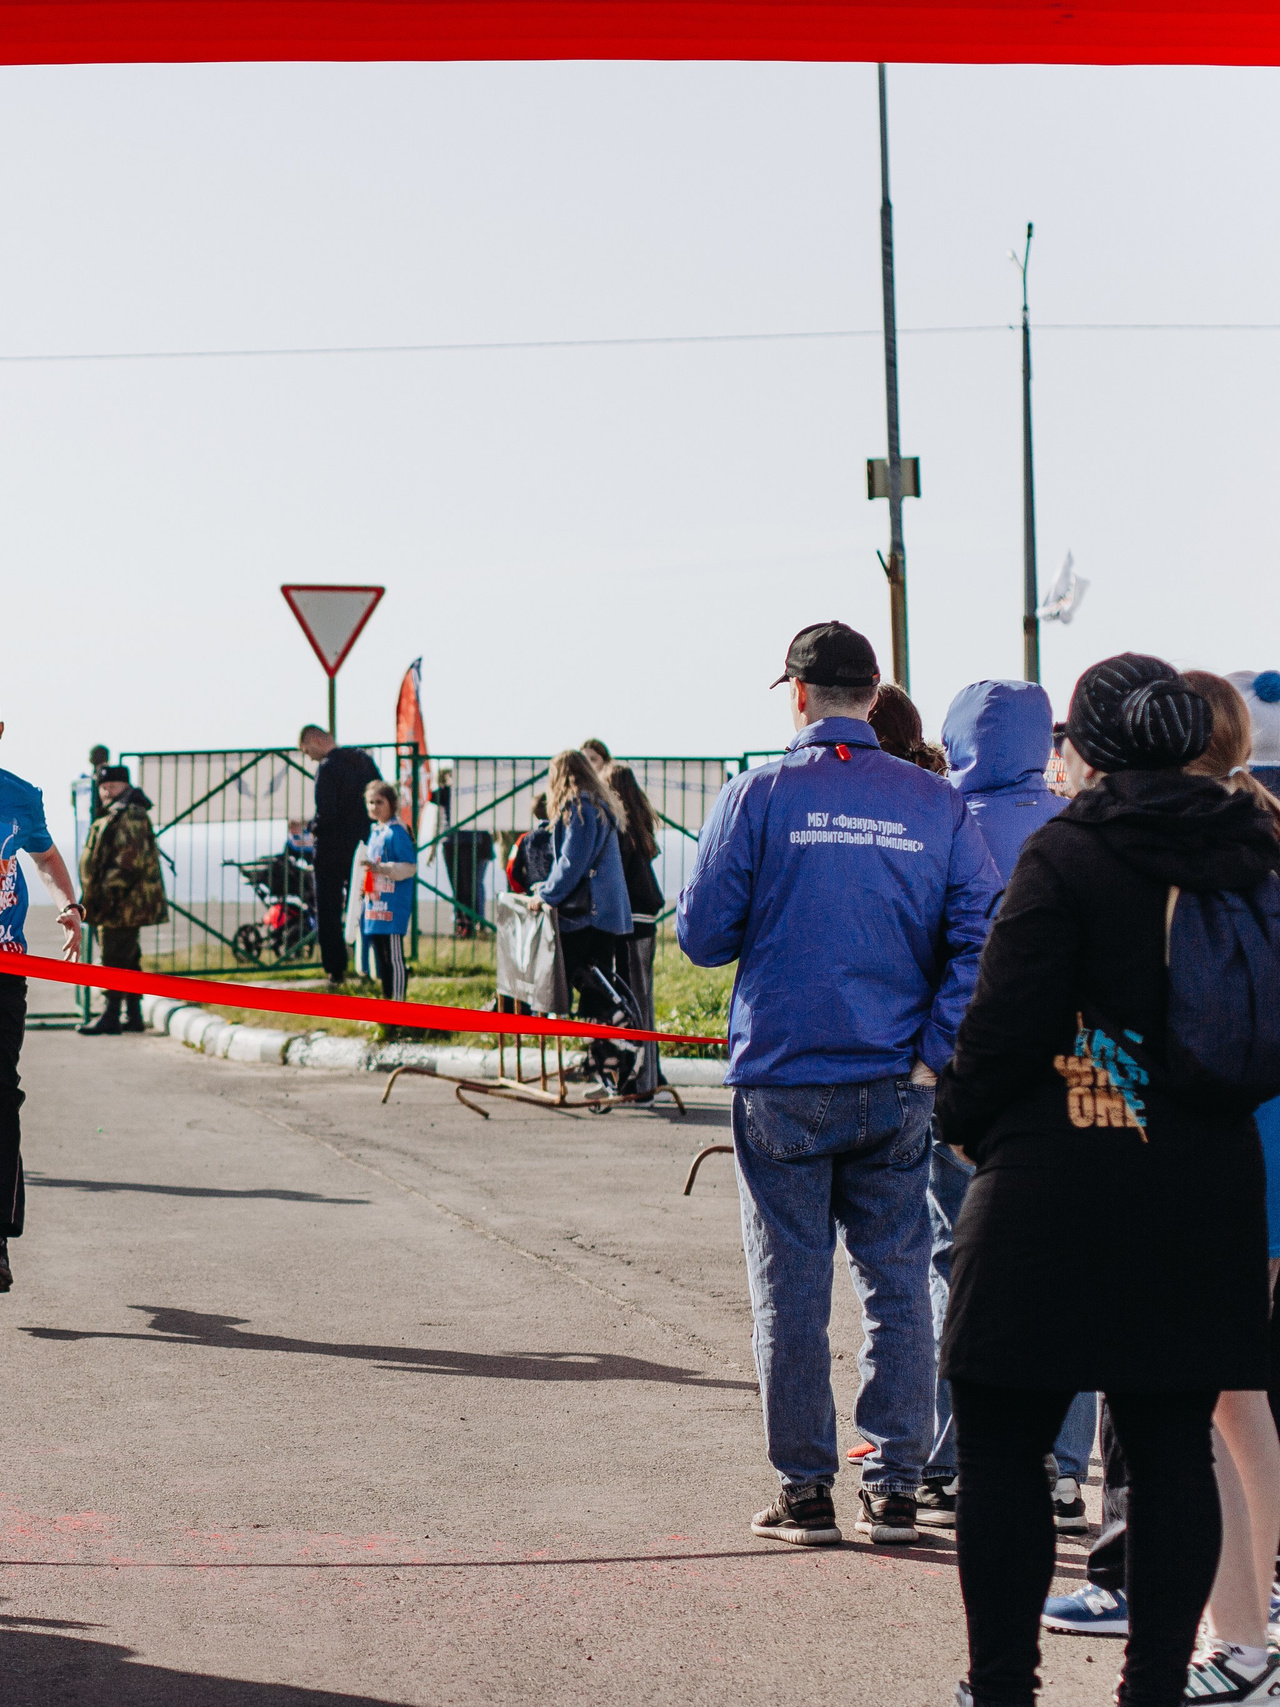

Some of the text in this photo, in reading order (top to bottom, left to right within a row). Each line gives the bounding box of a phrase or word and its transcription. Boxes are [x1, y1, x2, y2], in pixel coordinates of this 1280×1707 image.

[807, 812, 907, 835] МБУ «Физкультурно-
[790, 830, 924, 852] оздоровительный комплекс»
